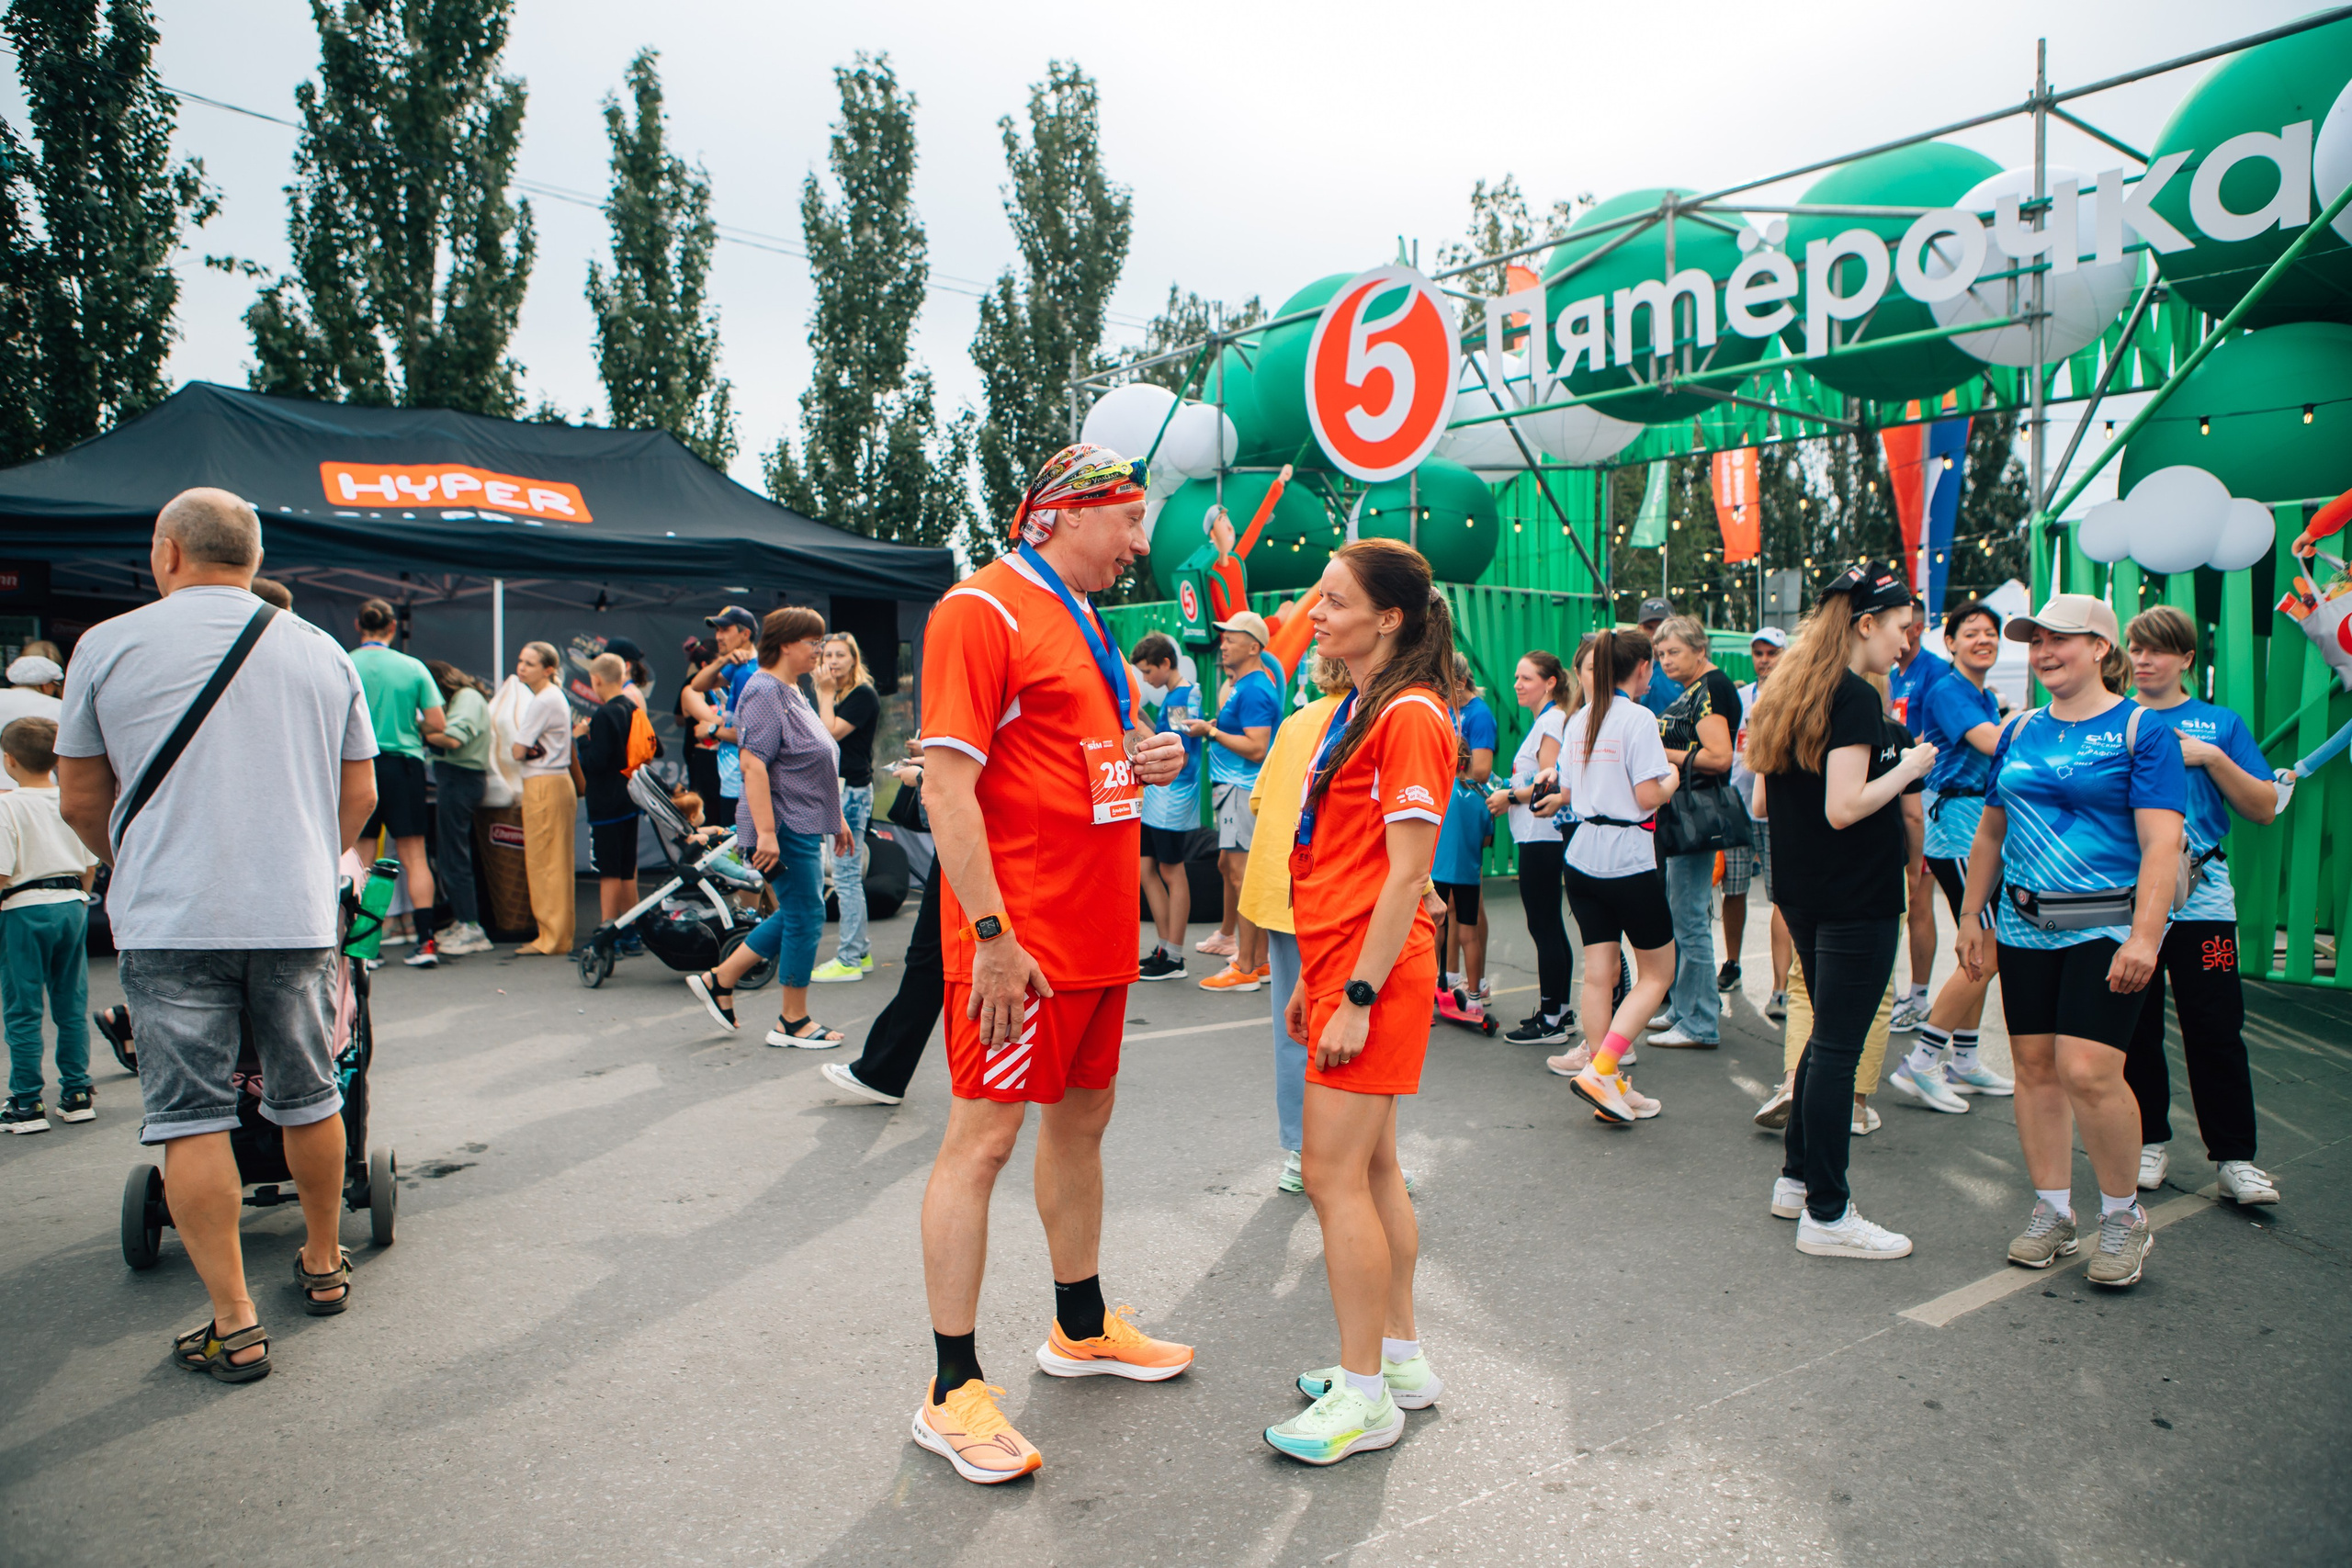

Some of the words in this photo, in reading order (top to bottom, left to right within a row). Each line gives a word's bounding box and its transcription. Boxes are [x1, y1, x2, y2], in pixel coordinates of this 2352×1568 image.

[1486, 119, 2312, 394] Пятёрочка
[1345, 278, 1420, 443] 5
[337, 472, 576, 515] HYPER
